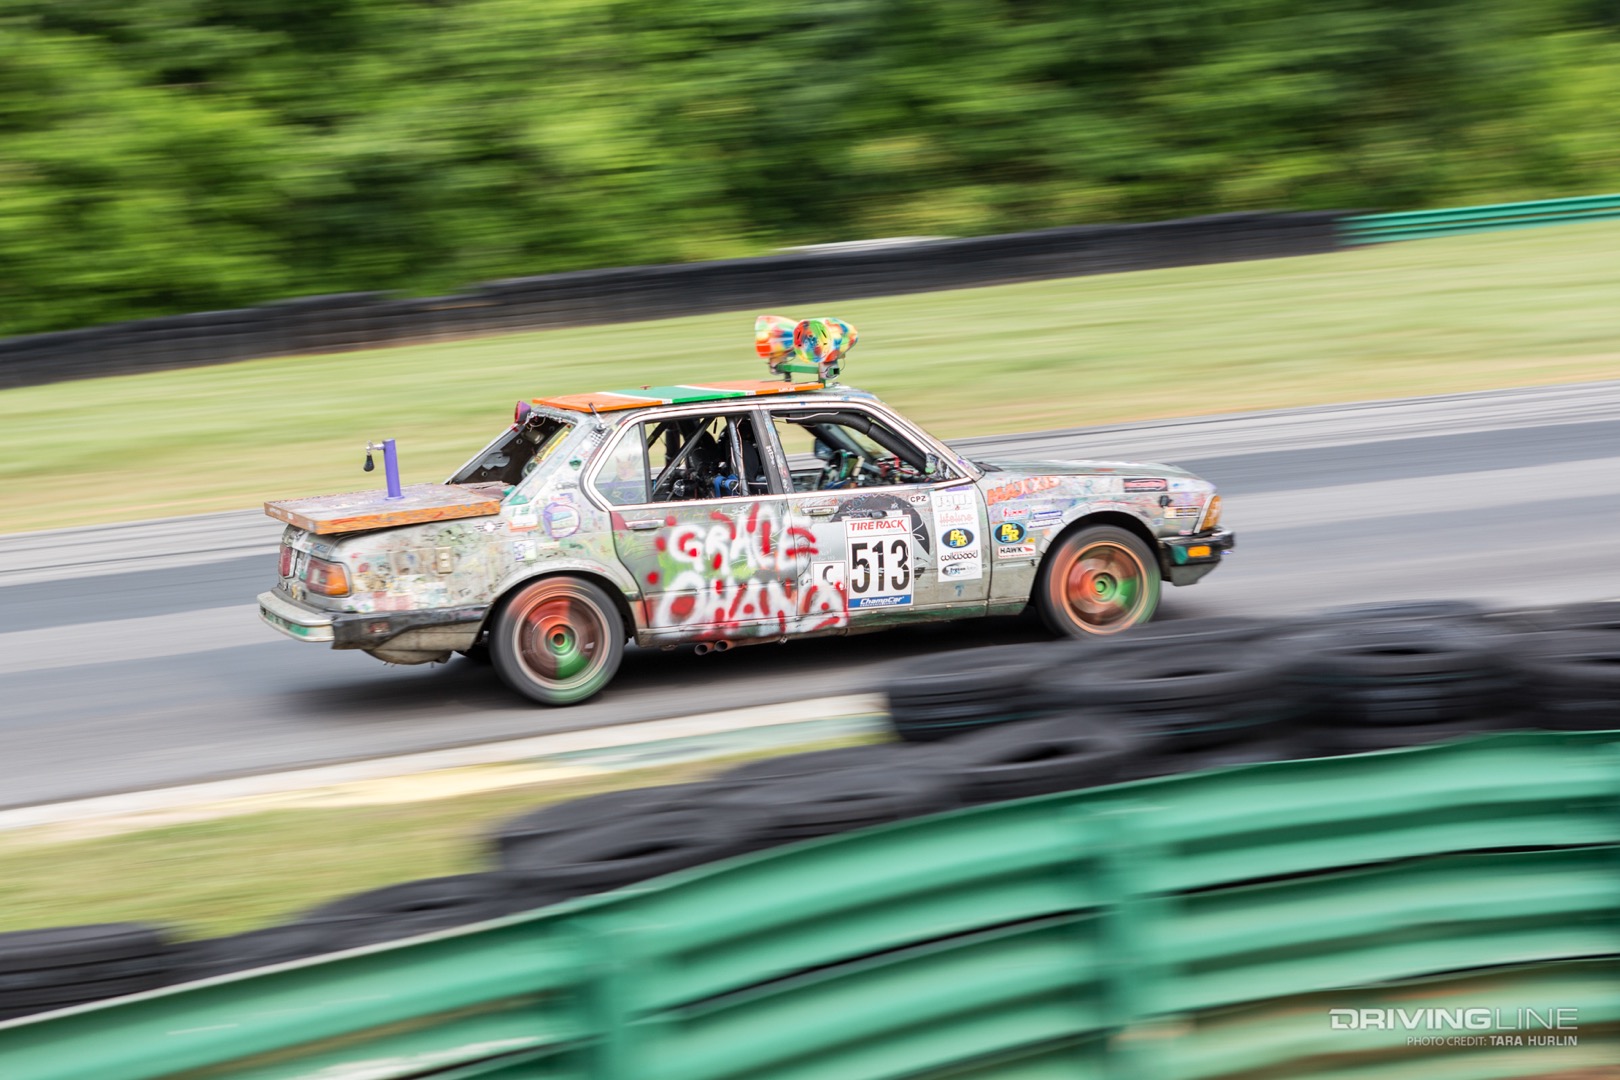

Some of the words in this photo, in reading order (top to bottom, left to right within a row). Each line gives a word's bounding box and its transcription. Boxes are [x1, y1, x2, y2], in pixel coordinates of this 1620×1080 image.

[987, 477, 1061, 506] MAXXIS
[850, 521, 875, 531] TIRE
[876, 519, 907, 532] RACK
[851, 539, 910, 594] 513
[860, 596, 902, 605] ChampCar
